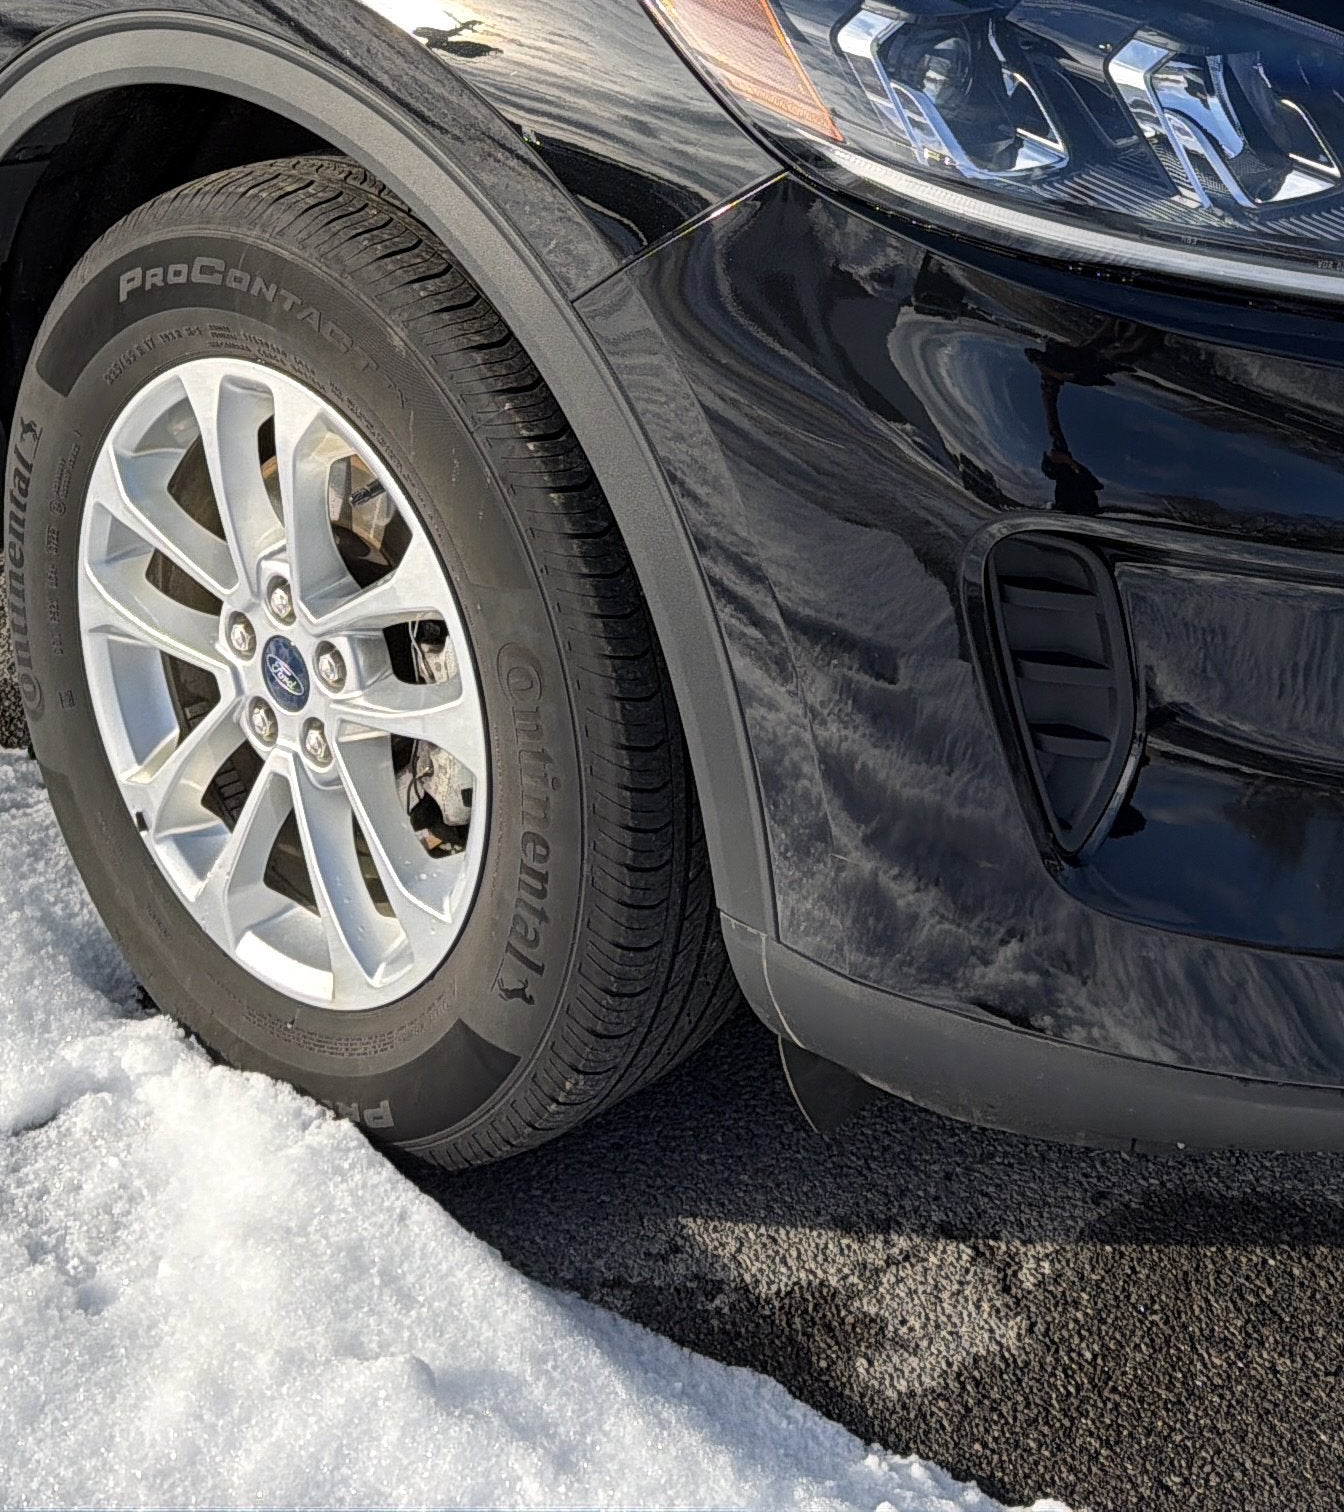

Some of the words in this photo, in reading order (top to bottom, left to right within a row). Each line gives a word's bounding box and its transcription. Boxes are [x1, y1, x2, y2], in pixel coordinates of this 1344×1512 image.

[143, 334, 157, 352] 17
[8, 443, 46, 723] Continental
[271, 660, 298, 691] Ford
[495, 641, 563, 977] Continental
